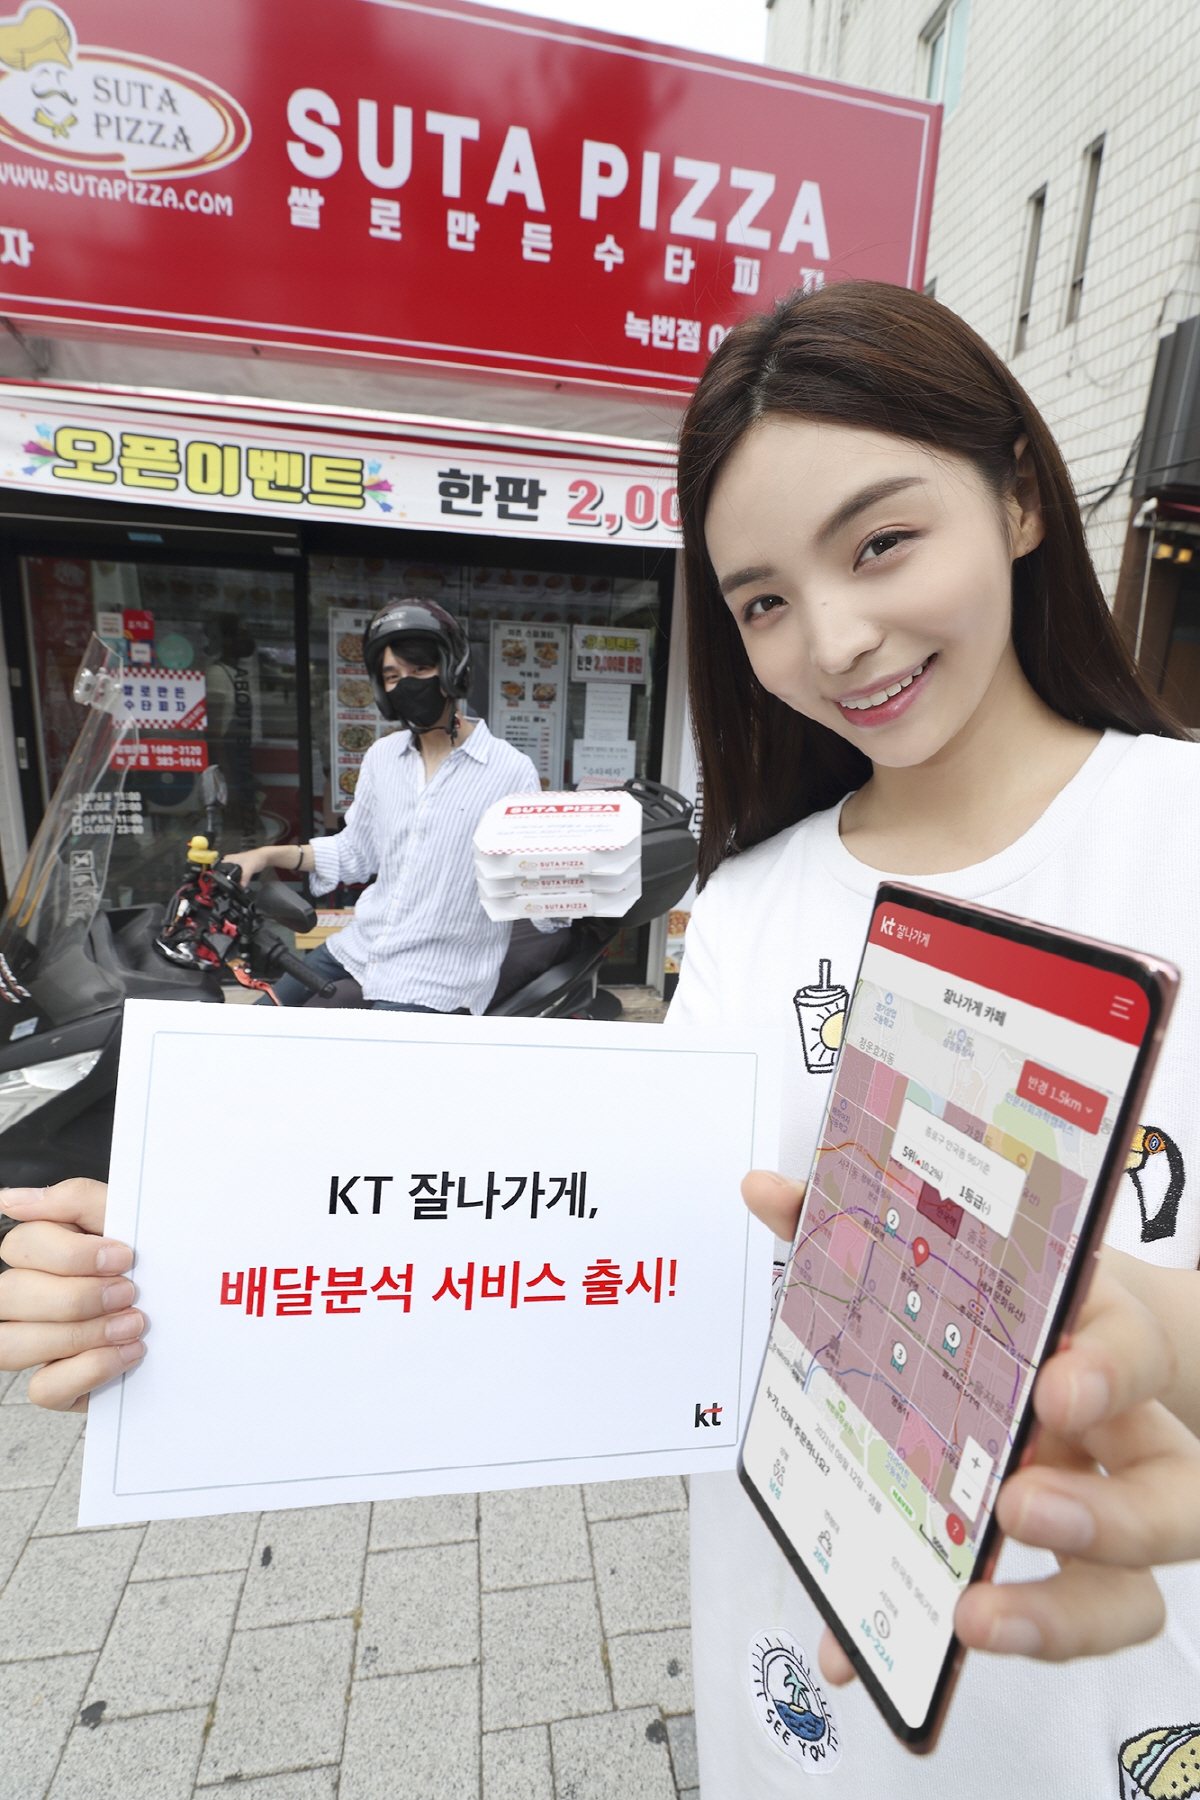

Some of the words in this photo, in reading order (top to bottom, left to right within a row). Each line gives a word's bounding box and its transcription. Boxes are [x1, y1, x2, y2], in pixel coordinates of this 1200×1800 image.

[93, 76, 179, 115] SUTA
[95, 112, 194, 153] PIZZA
[286, 87, 546, 213] SUTA
[580, 139, 831, 261] PIZZA
[624, 310, 701, 354] 녹번점
[52, 426, 366, 510] 오픈이벤트
[437, 468, 546, 521] 한판
[510, 805, 558, 814] SUTA
[562, 804, 616, 813] PIZZA
[879, 915, 896, 936] kt
[895, 923, 930, 948] 잘나가게
[942, 987, 983, 1017] 잘나가게
[982, 1004, 1006, 1027] 카페
[1026, 1074, 1048, 1096] 반경
[1048, 1085, 1082, 1113] 1.5km
[328, 1175, 393, 1215] KT
[407, 1171, 599, 1220] 잘나가게,
[220, 1264, 414, 1317] 배달분석
[432, 1260, 566, 1310] 서비스
[582, 1257, 678, 1306] 출시!
[694, 1402, 723, 1428] kt
[765, 1709, 791, 1746] SEE
[798, 1740, 826, 1762] YOU
